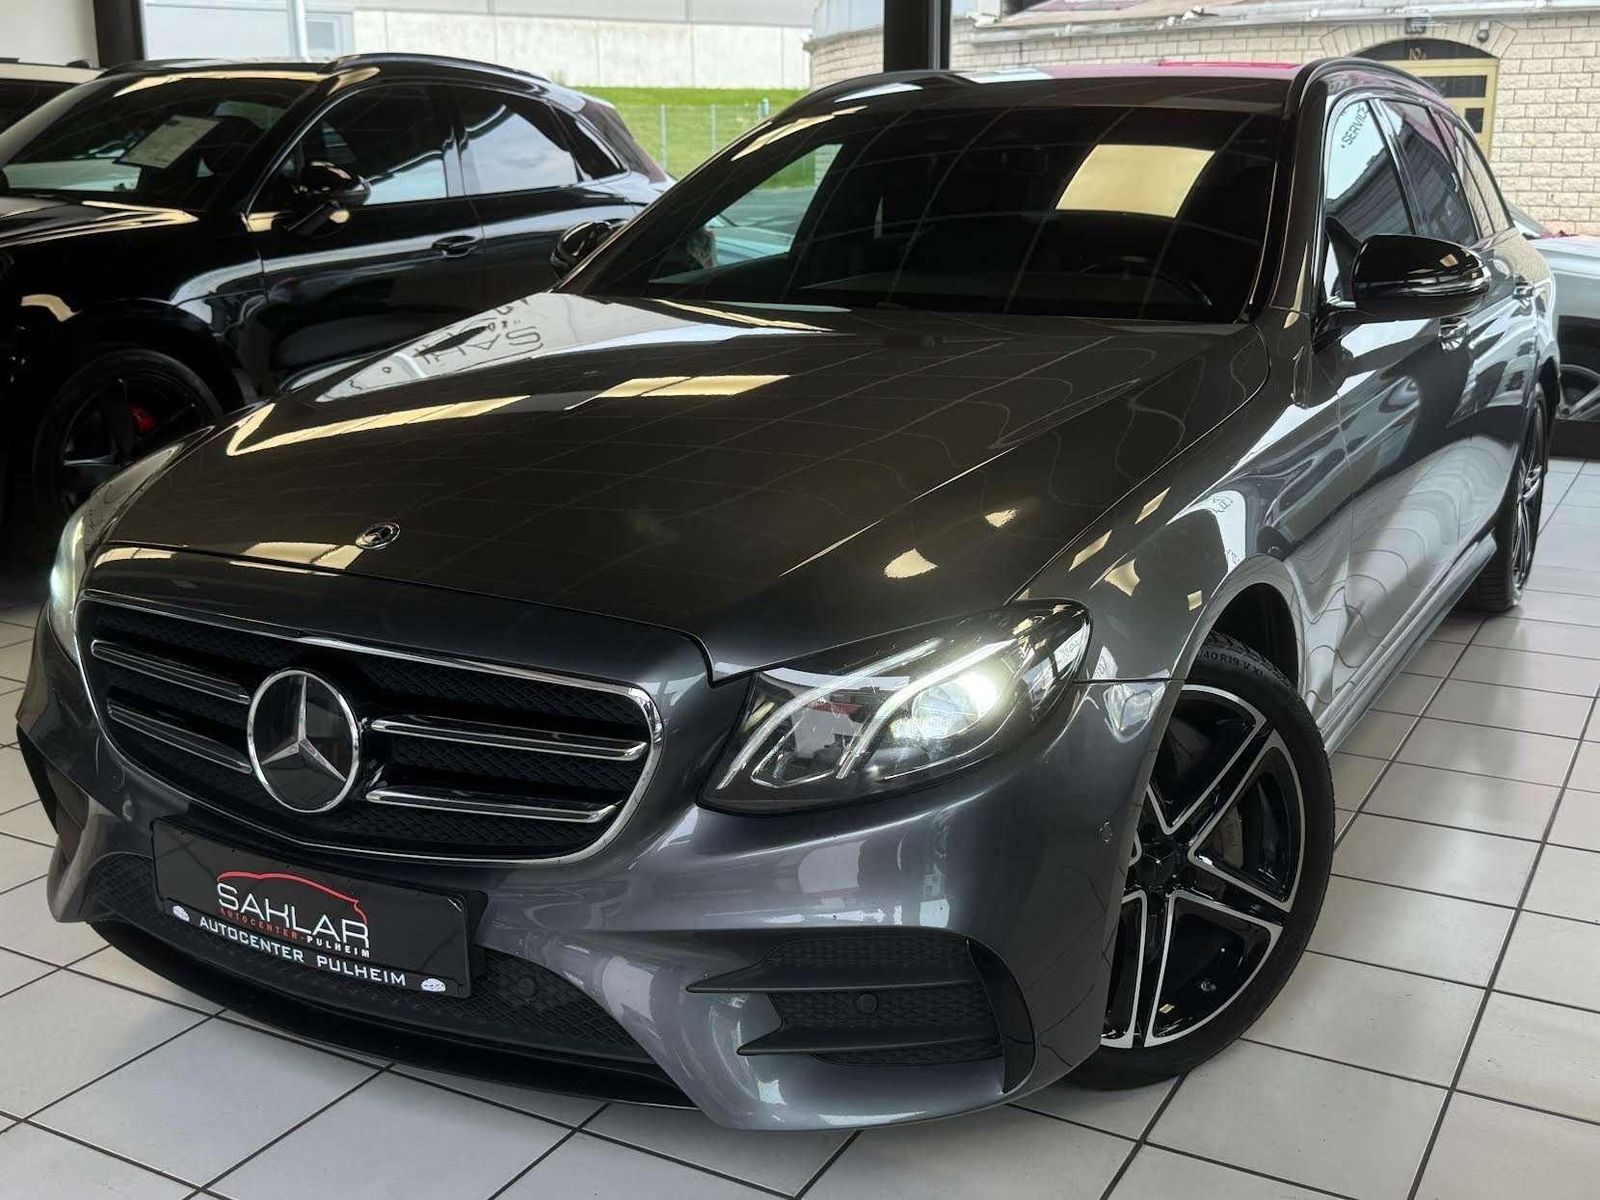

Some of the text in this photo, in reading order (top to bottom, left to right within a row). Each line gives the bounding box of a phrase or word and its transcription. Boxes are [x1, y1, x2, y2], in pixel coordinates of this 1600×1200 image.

[217, 882, 370, 949] SAHLAR
[200, 916, 407, 986] AUTOCENTER PULHEIM
